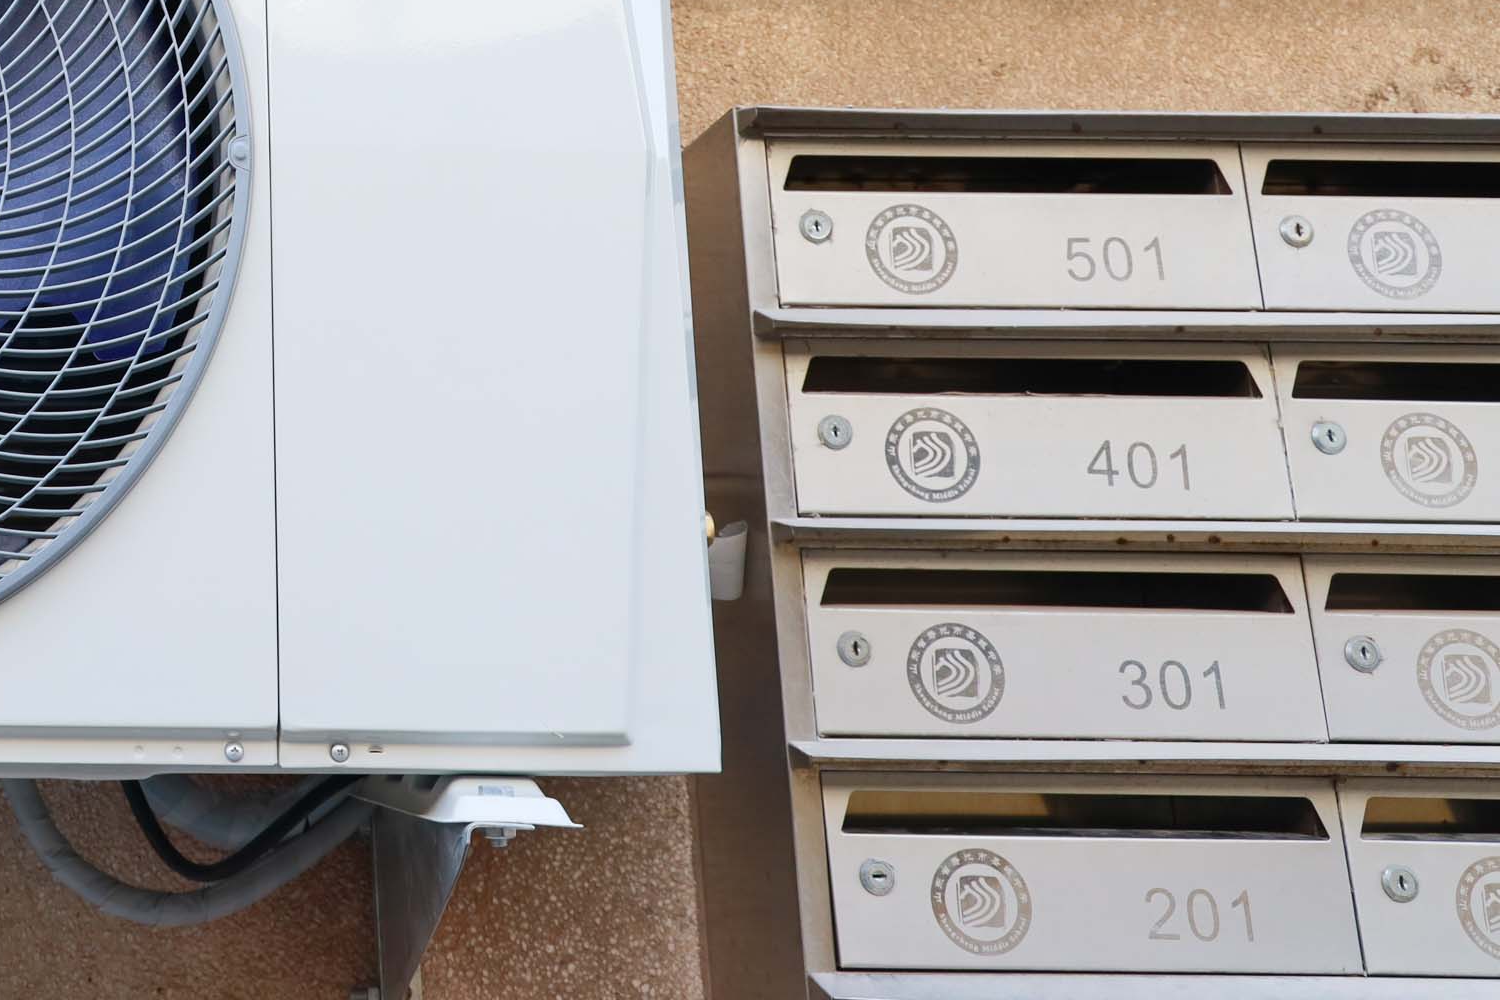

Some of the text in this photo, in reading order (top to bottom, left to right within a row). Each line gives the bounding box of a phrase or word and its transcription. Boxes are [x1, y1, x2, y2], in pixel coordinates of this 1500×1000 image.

[1067, 237, 1164, 281] 501
[1087, 440, 1190, 490] 401
[1119, 660, 1225, 710] 301
[1146, 888, 1253, 941] 201
